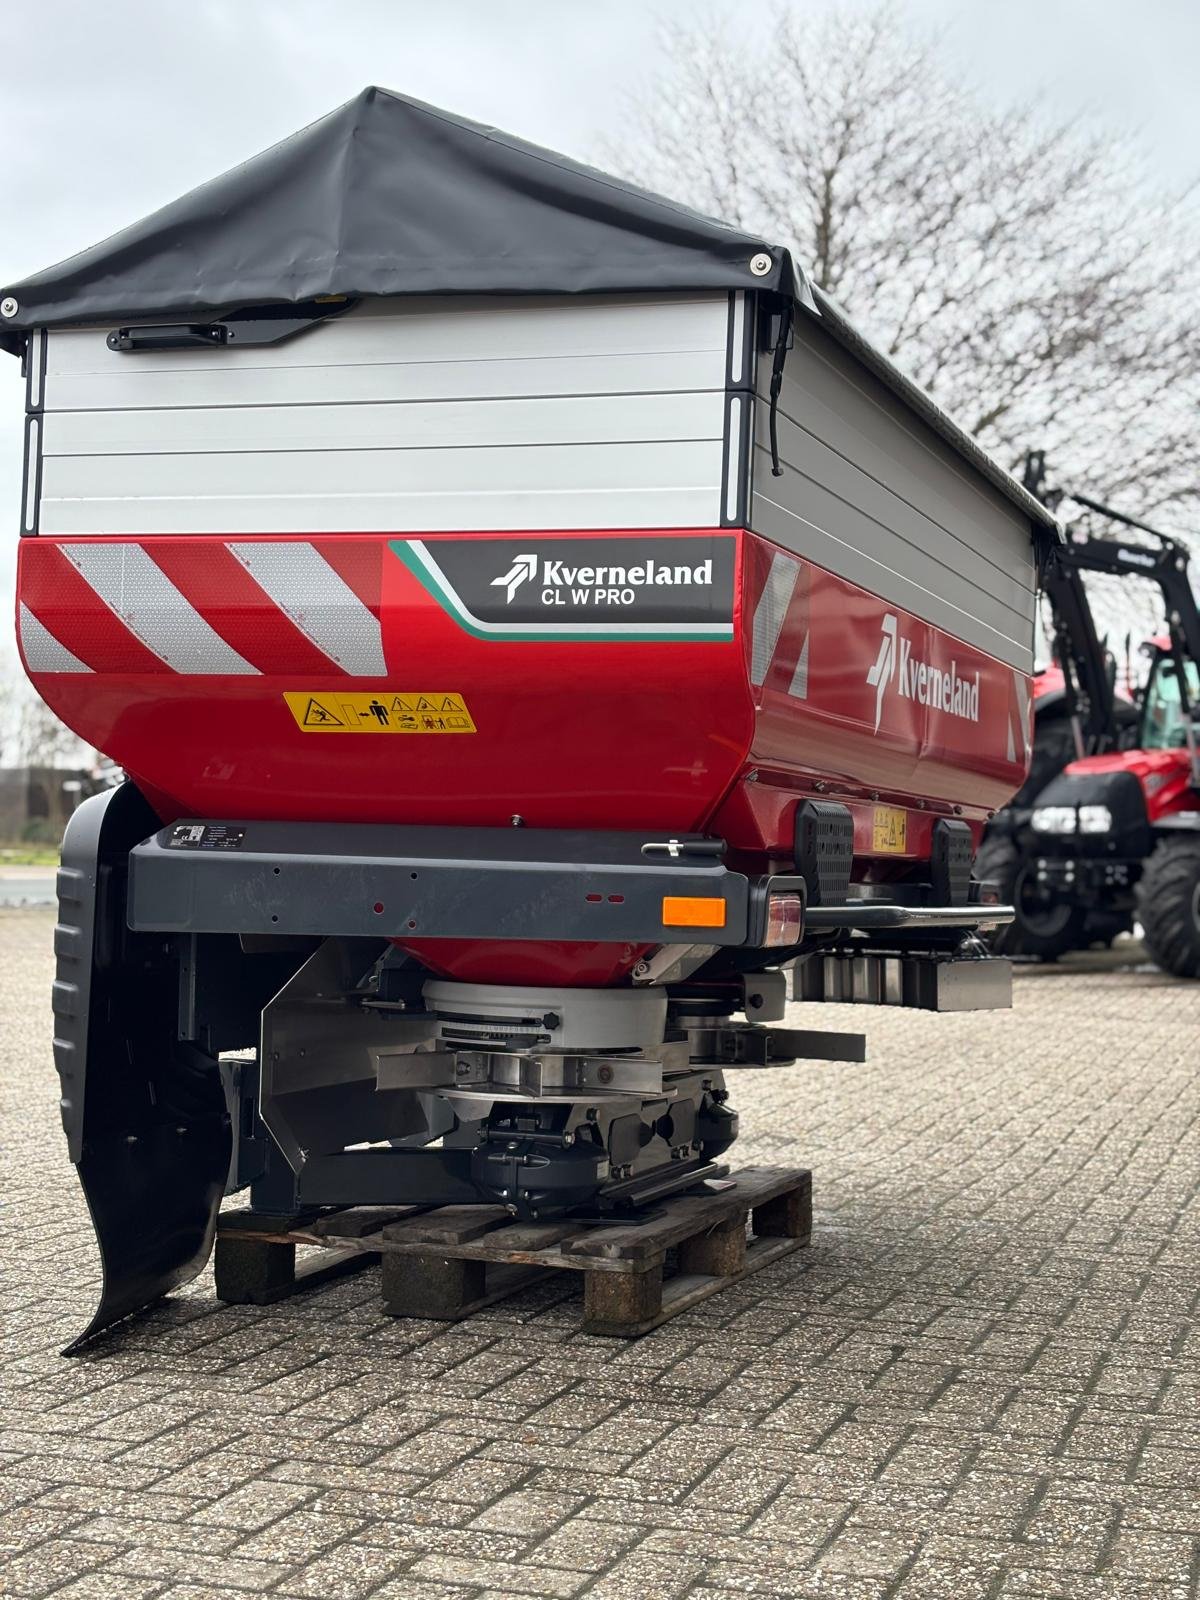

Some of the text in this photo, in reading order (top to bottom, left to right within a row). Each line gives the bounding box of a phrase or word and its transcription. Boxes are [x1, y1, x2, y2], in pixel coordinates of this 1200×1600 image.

[543, 560, 712, 586] Kverneland
[541, 589, 635, 605] CL W PRO
[898, 636, 980, 723] Kverneland
